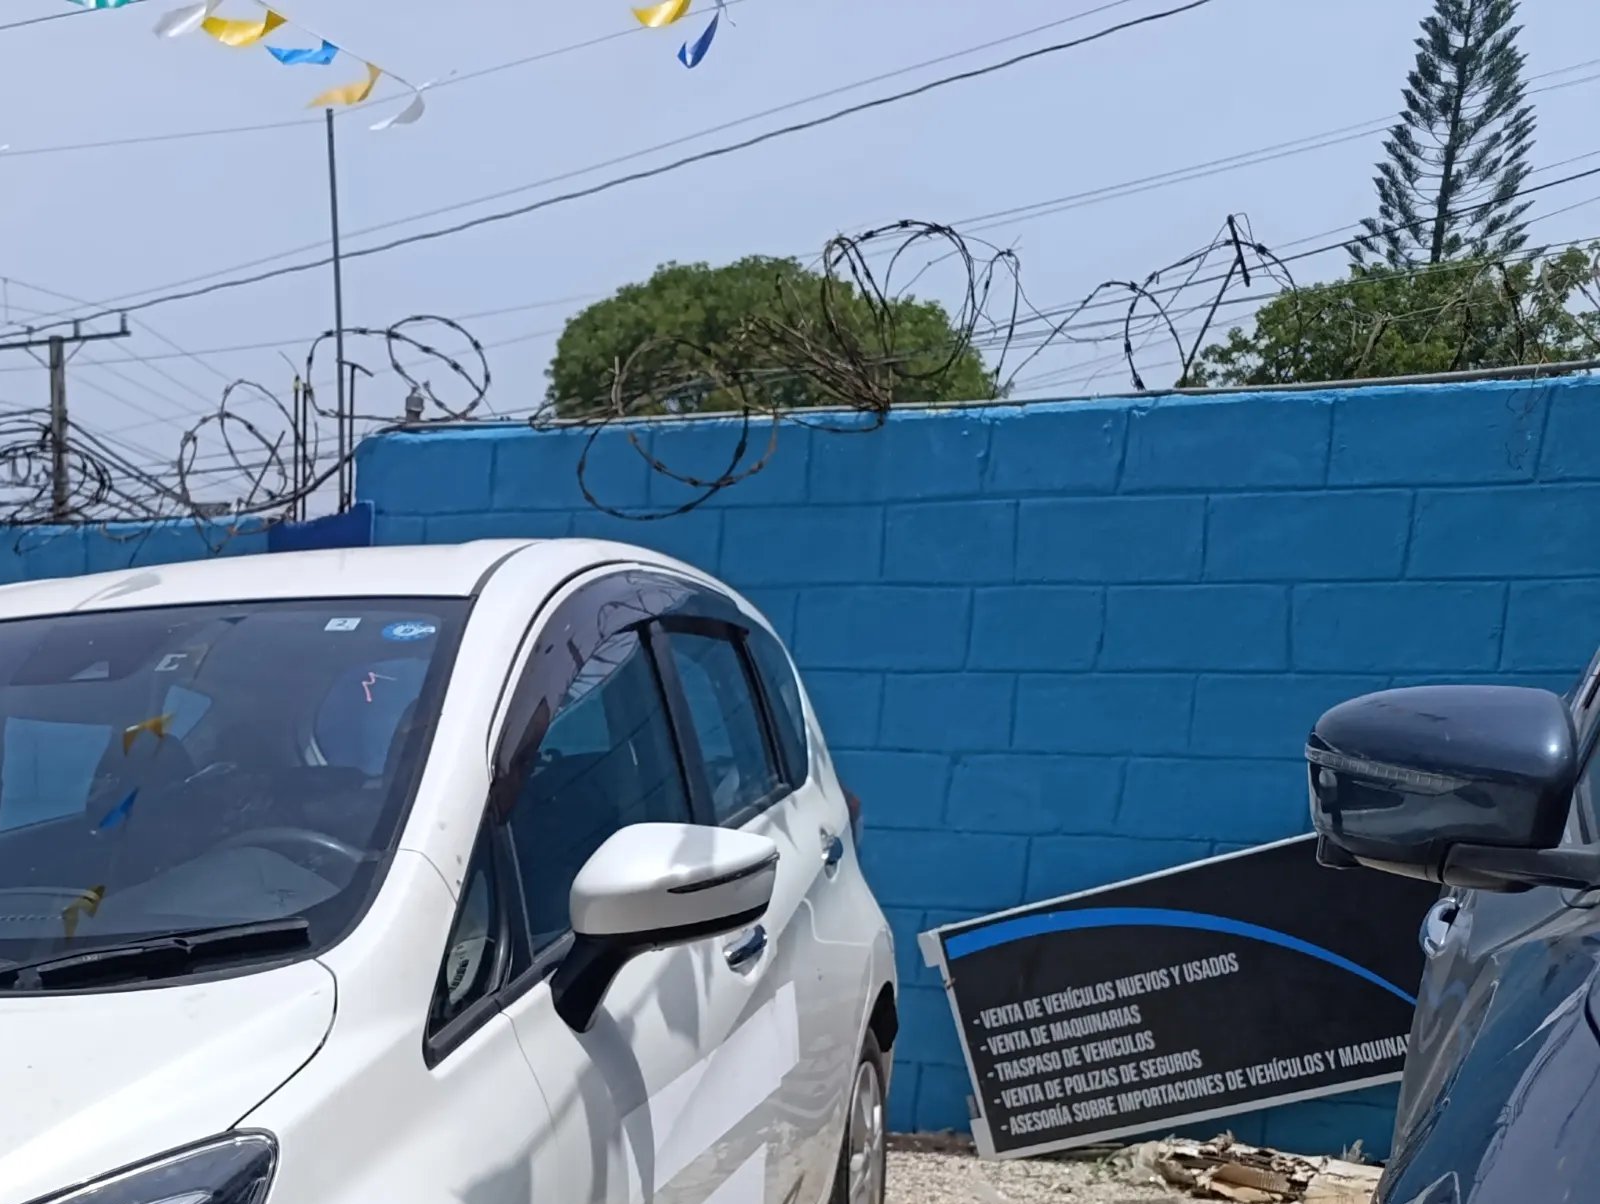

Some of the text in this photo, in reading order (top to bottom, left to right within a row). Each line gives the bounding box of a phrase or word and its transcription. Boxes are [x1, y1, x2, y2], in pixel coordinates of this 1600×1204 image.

[1024, 998, 1043, 1021] DE
[1042, 980, 1116, 1016] VEHÍCULOS
[1116, 968, 1170, 999] NUEVOS
[1167, 965, 1182, 986] Y
[1182, 952, 1239, 983] USADOS
[1031, 1024, 1050, 1048] DE
[1050, 1004, 1142, 1042] MAQUINARIAS
[1062, 1046, 1082, 1068] DE
[1081, 1030, 1155, 1063] VEHICULOS
[1044, 1079, 1064, 1100] DE
[1064, 1066, 1119, 1096] POLIZAS
[1120, 1062, 1140, 1084] DE
[1140, 1048, 1203, 1079] SEGUROS
[1072, 1096, 1118, 1122] SOBRE
[1117, 1074, 1226, 1113] IMPORTACIONES
[1226, 1068, 1247, 1091] DE
[1246, 1051, 1325, 1086] VEHÍCULOS
[1324, 1049, 1336, 1070] Y
